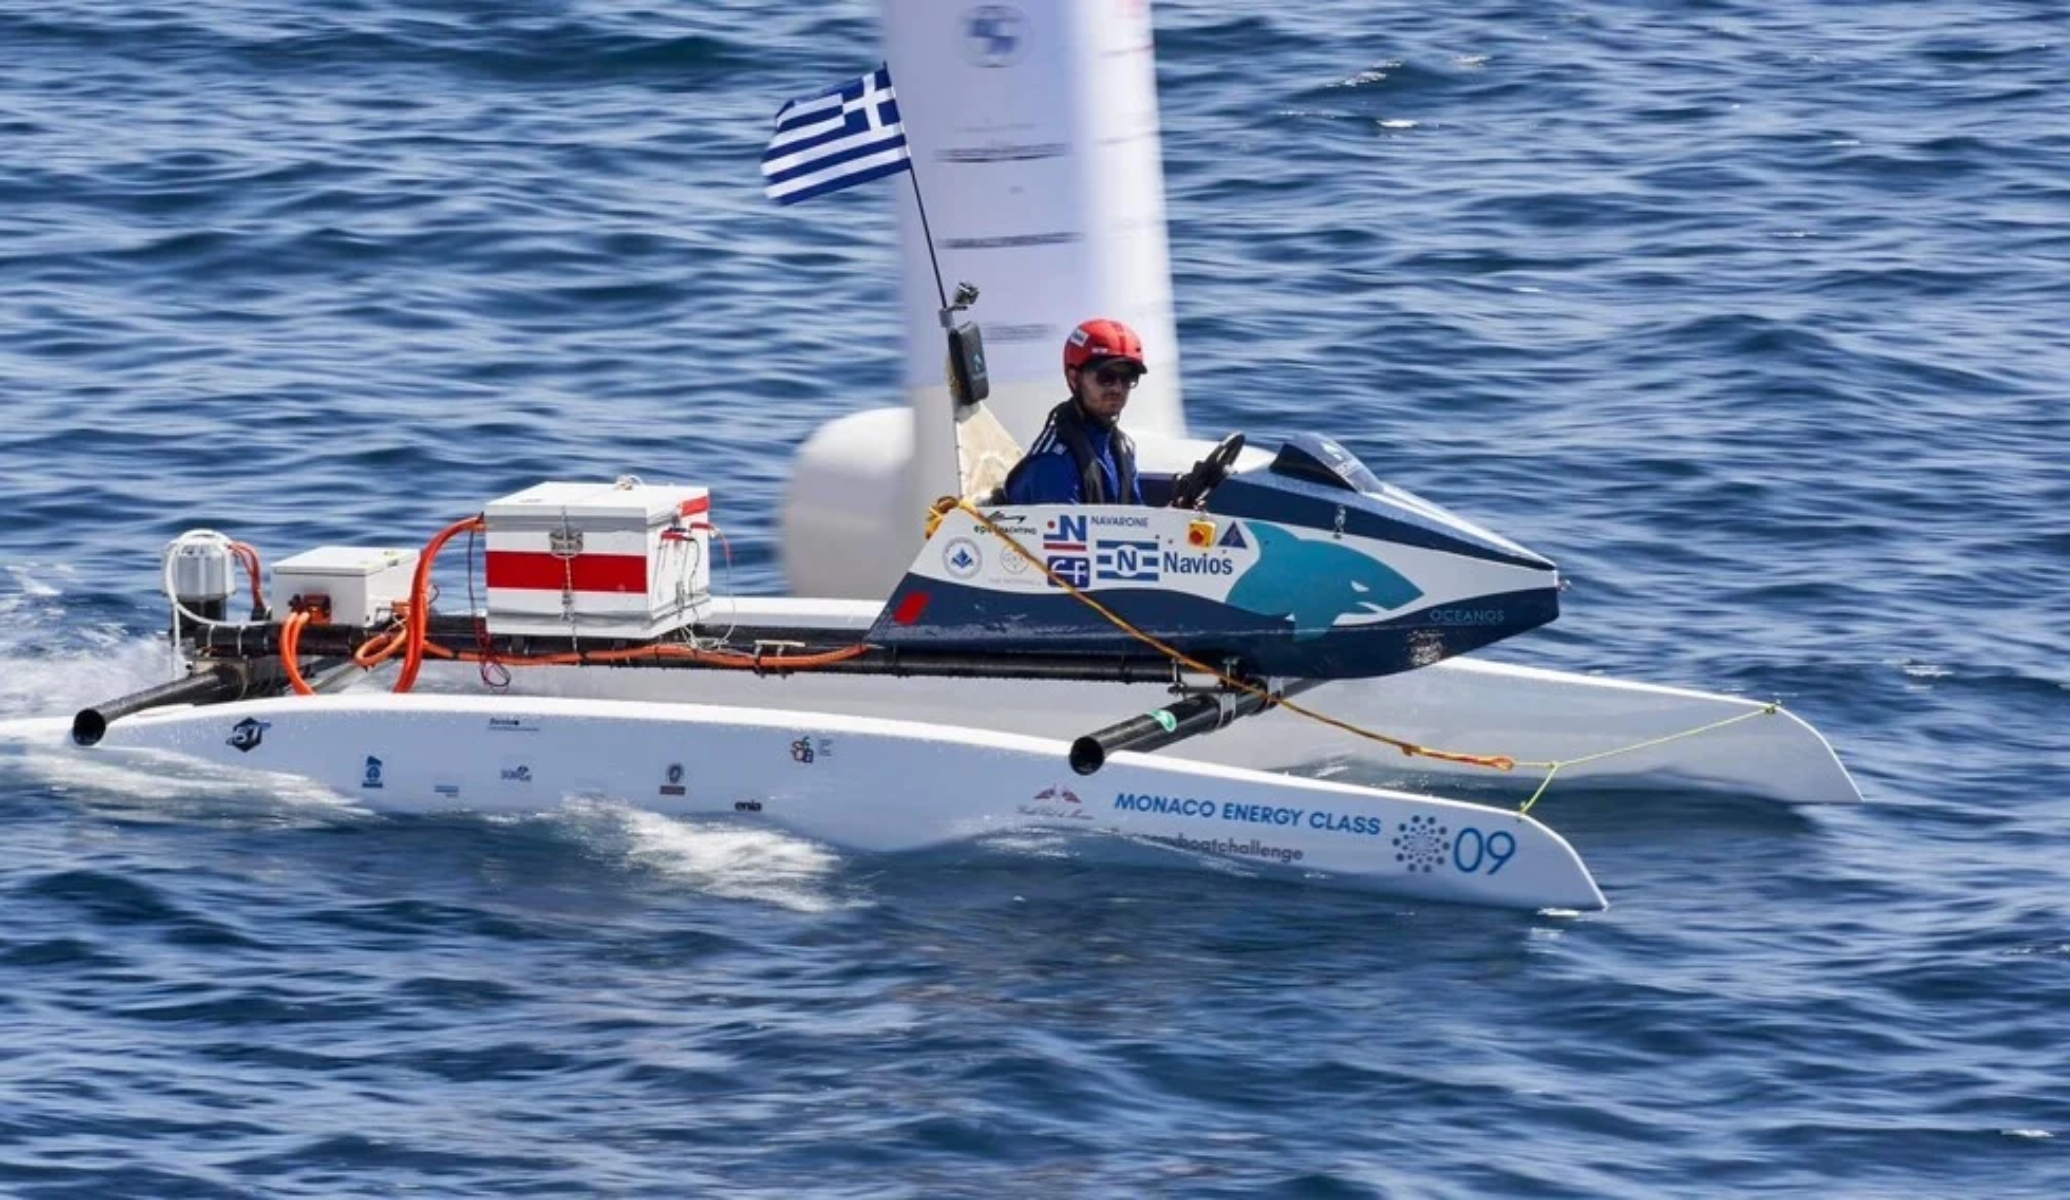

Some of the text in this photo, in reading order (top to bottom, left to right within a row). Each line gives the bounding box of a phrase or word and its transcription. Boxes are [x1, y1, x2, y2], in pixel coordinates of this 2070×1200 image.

[1163, 551, 1233, 575] Navios
[1429, 609, 1505, 622] OCEANOS
[1114, 793, 1216, 818] MONACO
[1222, 802, 1304, 827] ENERGY
[1308, 811, 1382, 836] CLASS
[1453, 827, 1516, 875] 09
